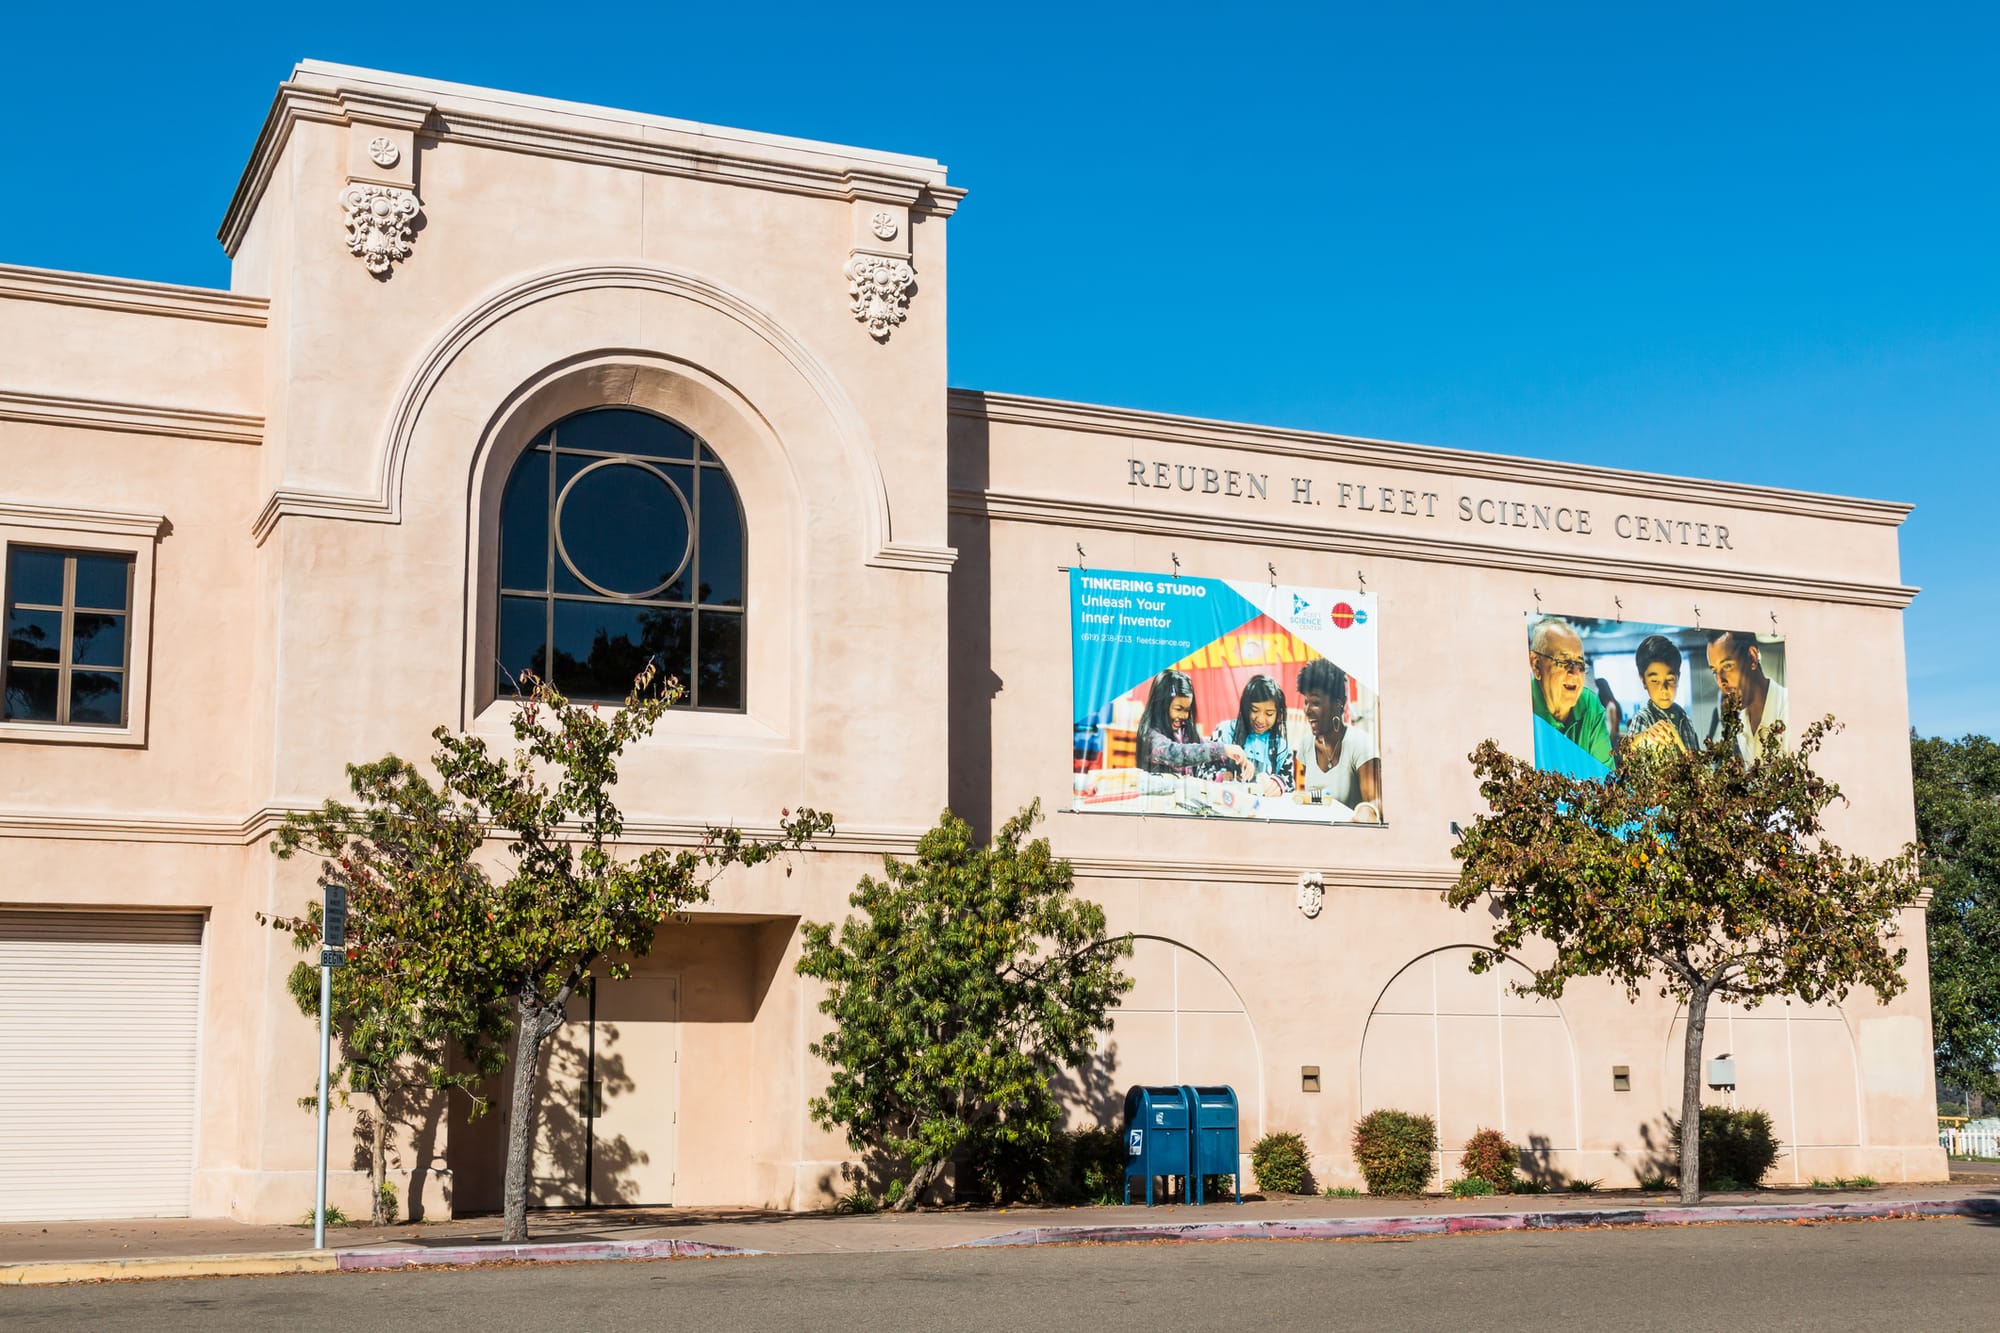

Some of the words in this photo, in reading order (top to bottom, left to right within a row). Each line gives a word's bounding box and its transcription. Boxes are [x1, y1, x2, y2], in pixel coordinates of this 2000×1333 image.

[1127, 458, 1269, 501] REUBEN
[1290, 476, 1321, 506] H.
[1336, 481, 1440, 518] FLEET
[1457, 495, 1593, 535] SCIENCE
[1613, 513, 1734, 551] CENTER
[1080, 576, 1154, 593] TINKERING
[1156, 582, 1207, 598] STUDIO
[1081, 594, 1132, 608] Unleash
[1136, 598, 1166, 611] Your
[1081, 611, 1115, 625] Inner
[1119, 614, 1172, 629] Inventor
[1290, 616, 1321, 625] SCIENCE
[1136, 636, 1191, 648] fleetscience.org
[323, 952, 344, 965] BEGIN
